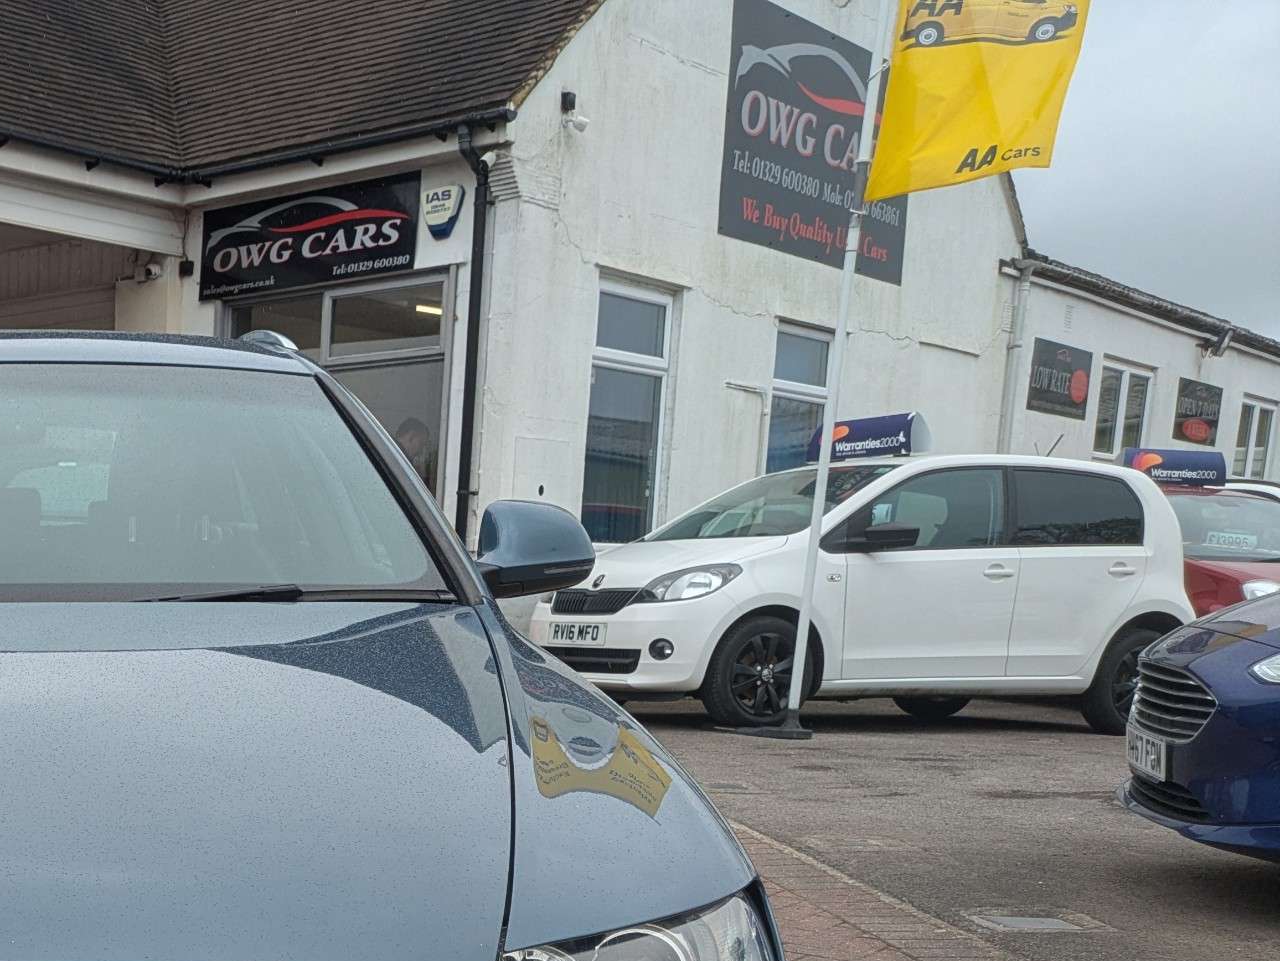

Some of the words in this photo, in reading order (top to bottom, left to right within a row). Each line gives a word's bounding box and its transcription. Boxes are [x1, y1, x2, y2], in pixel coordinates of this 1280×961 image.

[741, 90, 817, 157] OWG
[955, 144, 998, 173] AA
[1001, 146, 1041, 161] cars
[733, 150, 751, 174] Tel:
[752, 157, 781, 184] 01329
[782, 168, 820, 198] 600380
[426, 190, 452, 204] IAS
[743, 197, 760, 224] We
[764, 203, 788, 241] Buy
[789, 212, 834, 255] Quality
[213, 237, 293, 273] OWG
[301, 218, 402, 258] CARS
[347, 260, 373, 273] 01329
[374, 254, 410, 269] 600380
[1151, 468, 1217, 480] Warranties2000
[553, 624, 576, 640] RV16
